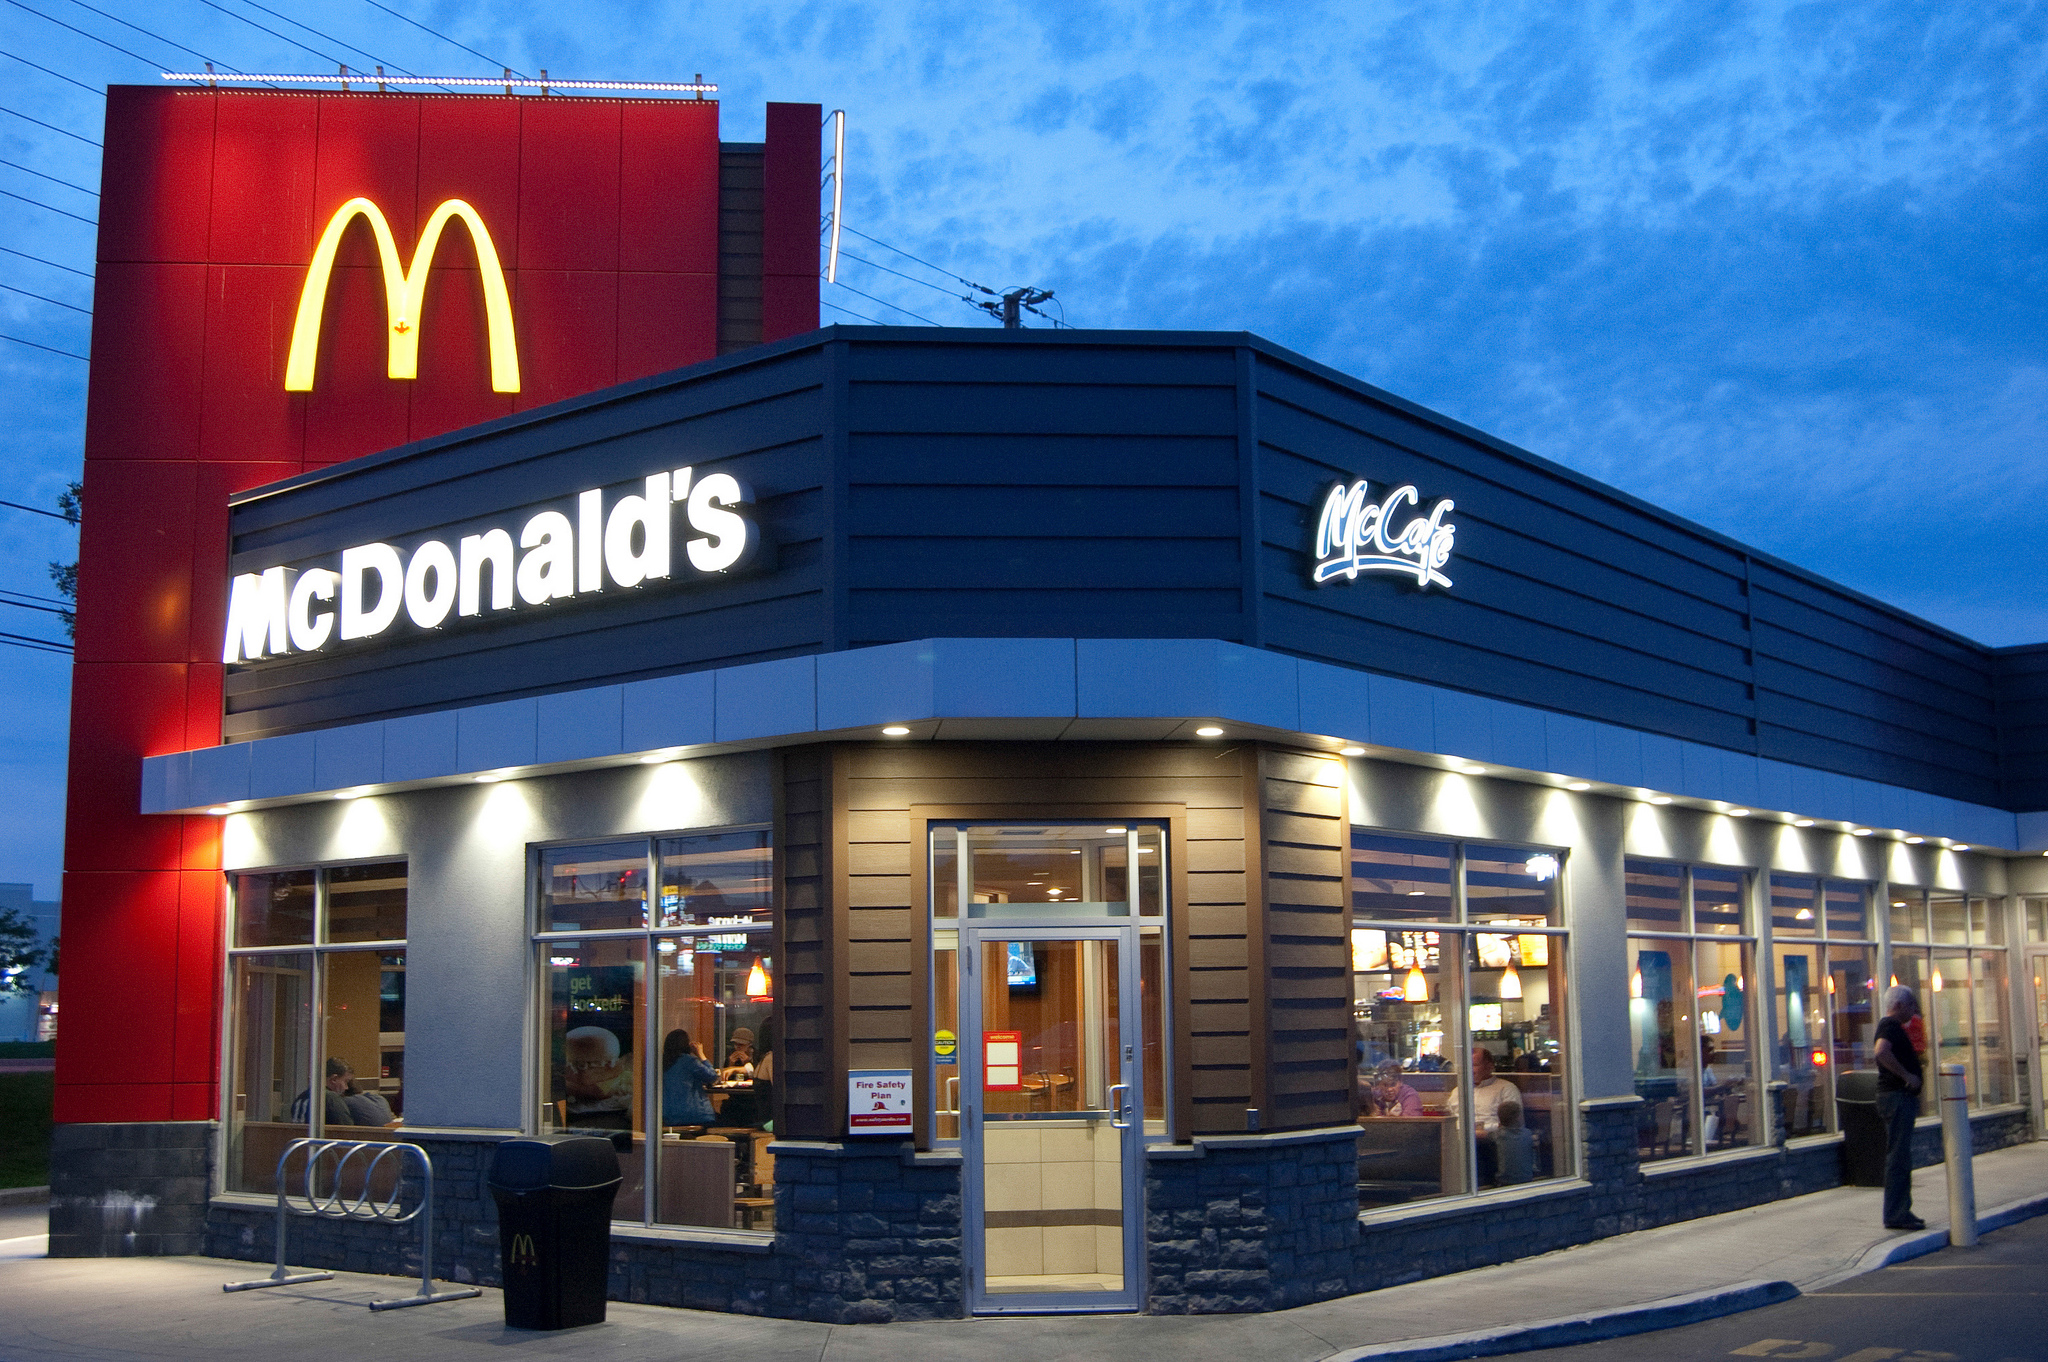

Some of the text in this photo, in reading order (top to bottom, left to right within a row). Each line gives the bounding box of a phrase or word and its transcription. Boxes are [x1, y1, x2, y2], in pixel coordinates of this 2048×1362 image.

[223, 467, 747, 665] McDonald's
[570, 975, 592, 994] get
[570, 994, 623, 1012] hooked!
[856, 1081, 906, 1089] Fire Safety
